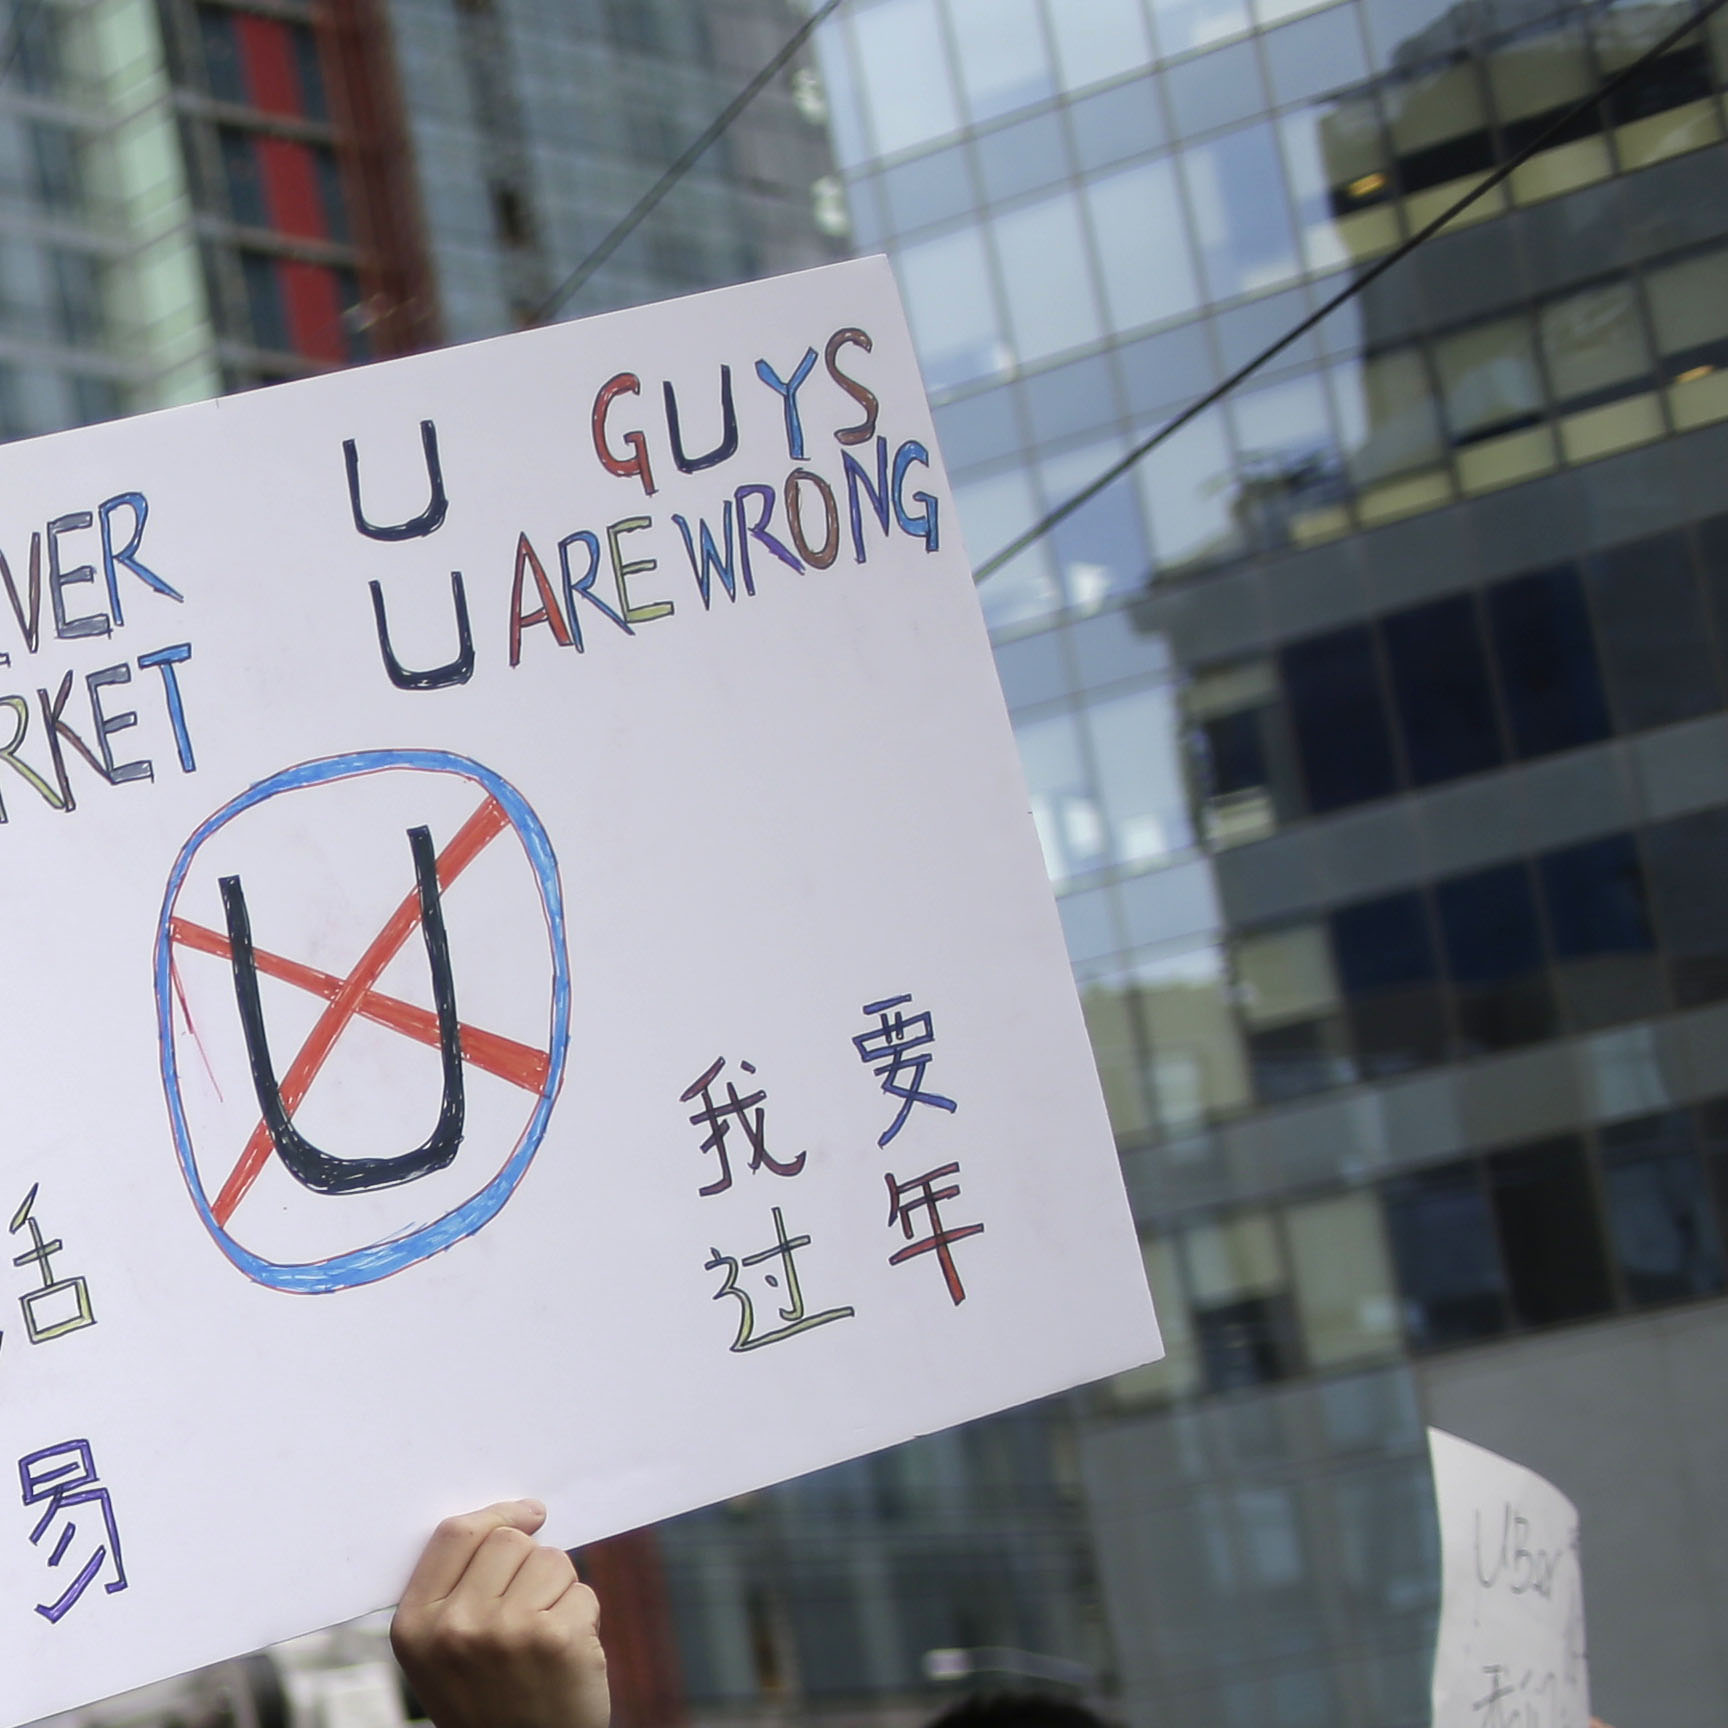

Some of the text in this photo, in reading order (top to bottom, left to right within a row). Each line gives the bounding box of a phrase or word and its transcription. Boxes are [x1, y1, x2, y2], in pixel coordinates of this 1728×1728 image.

[343, 327, 879, 541] U GUYS
[369, 436, 940, 691] U ARE WRONG
